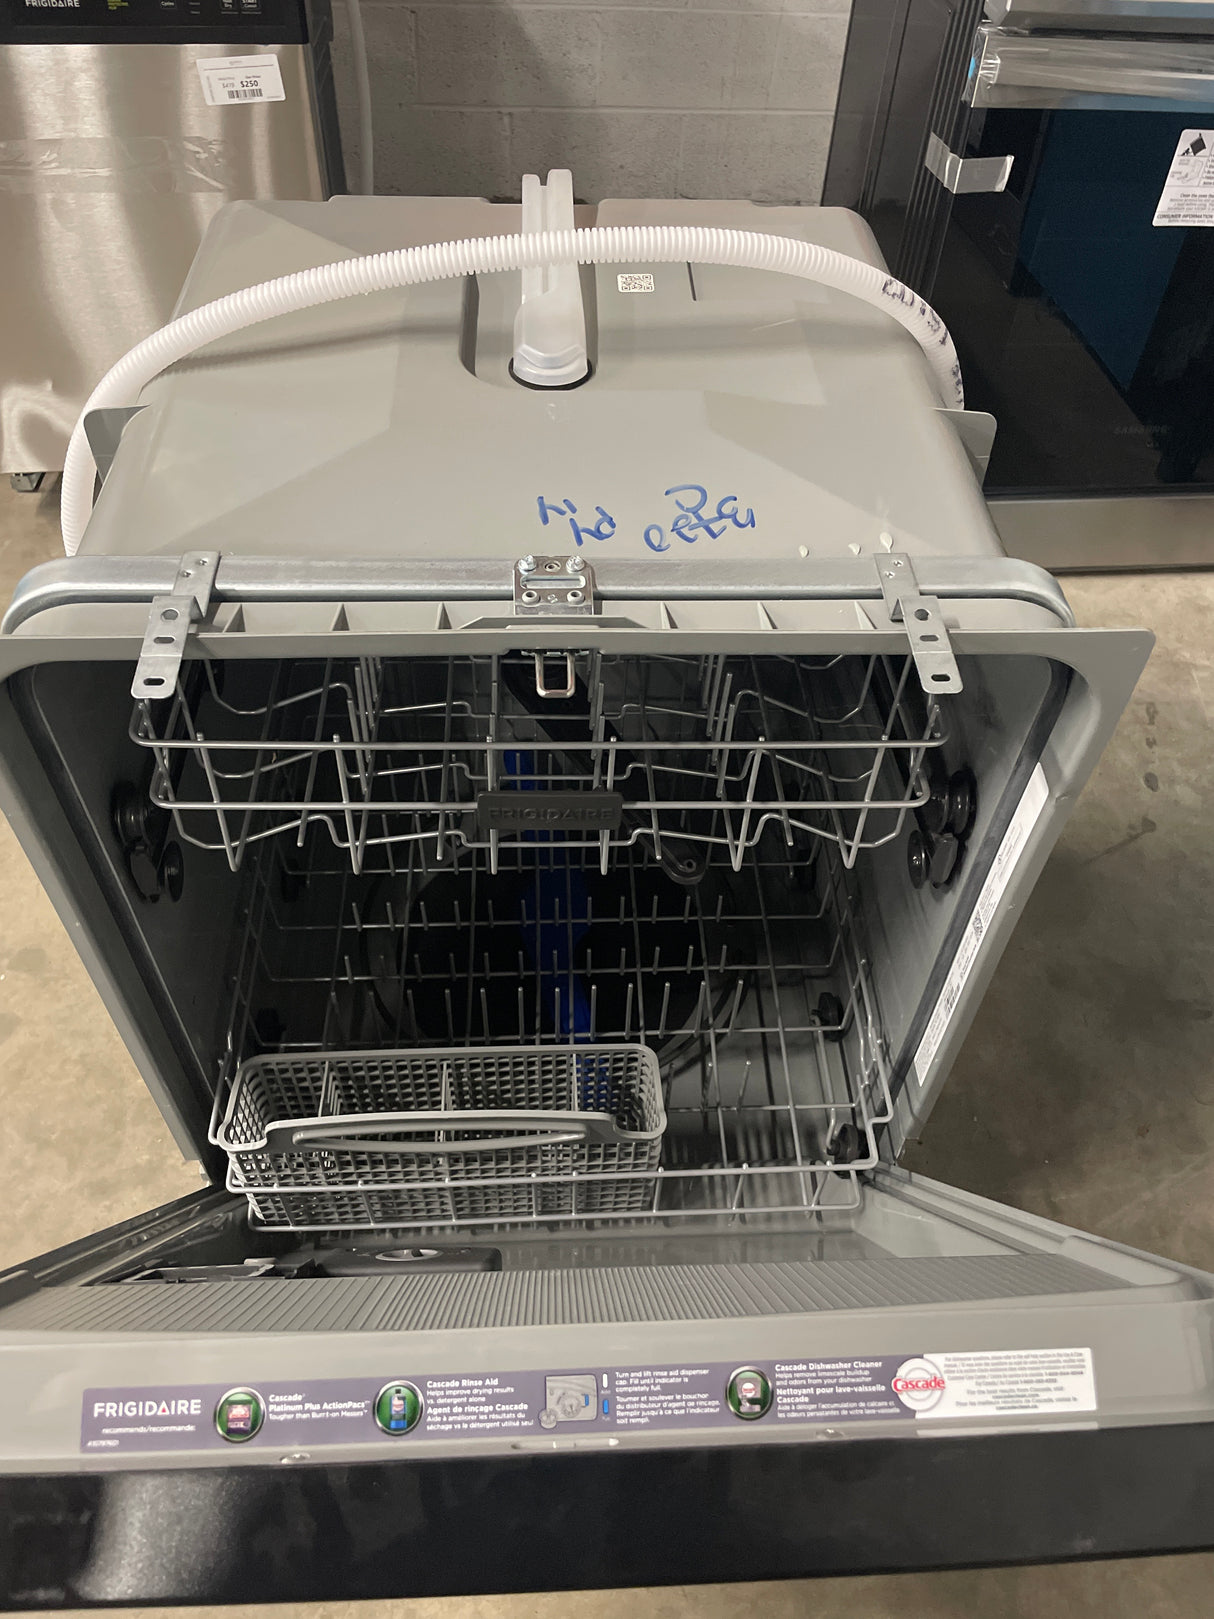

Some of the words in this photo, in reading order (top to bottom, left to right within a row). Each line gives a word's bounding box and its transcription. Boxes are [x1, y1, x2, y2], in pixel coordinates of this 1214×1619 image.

[240, 80, 258, 88] $250
[488, 807, 615, 821] FRIGIDAIRE
[775, 1363, 807, 1371] Cascade
[809, 1362, 851, 1370] Dishwasher
[853, 1361, 882, 1369] Cleaner
[653, 1369, 668, 1377] rinse
[669, 1368, 679, 1376] aid
[680, 1368, 710, 1376] dispenser
[846, 1369, 870, 1377] buildup
[427, 1380, 459, 1388] Cascade
[461, 1379, 483, 1387] Rinse
[485, 1378, 498, 1386] Aid
[807, 1377, 823, 1385] from
[824, 1377, 837, 1385] your
[893, 1376, 946, 1392] Cascade
[427, 1389, 444, 1397] Helps
[445, 1388, 471, 1396] improve
[472, 1386, 492, 1395] drying
[616, 1385, 650, 1393] completely
[777, 1387, 814, 1397] Nettoyant
[816, 1387, 834, 1396] pour
[835, 1384, 886, 1393] lave-vaisselle
[436, 1396, 467, 1404] detergent
[616, 1395, 640, 1403] Tourner
[648, 1394, 674, 1402] soulever
[777, 1395, 809, 1404] Cascade
[93, 1399, 201, 1418] FRIGIDAIRE
[269, 1404, 303, 1412] Platinum
[304, 1402, 320, 1411] Plus
[427, 1406, 450, 1415] Agent
[453, 1405, 462, 1413] de
[464, 1404, 493, 1413] rinçage
[495, 1402, 528, 1411] Cascade
[625, 1402, 661, 1410] distributeur
[269, 1413, 294, 1421] Tougher
[448, 1412, 477, 1421] améliorer
[479, 1412, 488, 1420] les
[489, 1411, 516, 1419] résultats
[517, 1410, 525, 1418] du
[616, 1409, 640, 1417] Remplir
[427, 1422, 452, 1431] séchage
[469, 1420, 500, 1429] détergent
[616, 1417, 628, 1425] soit
